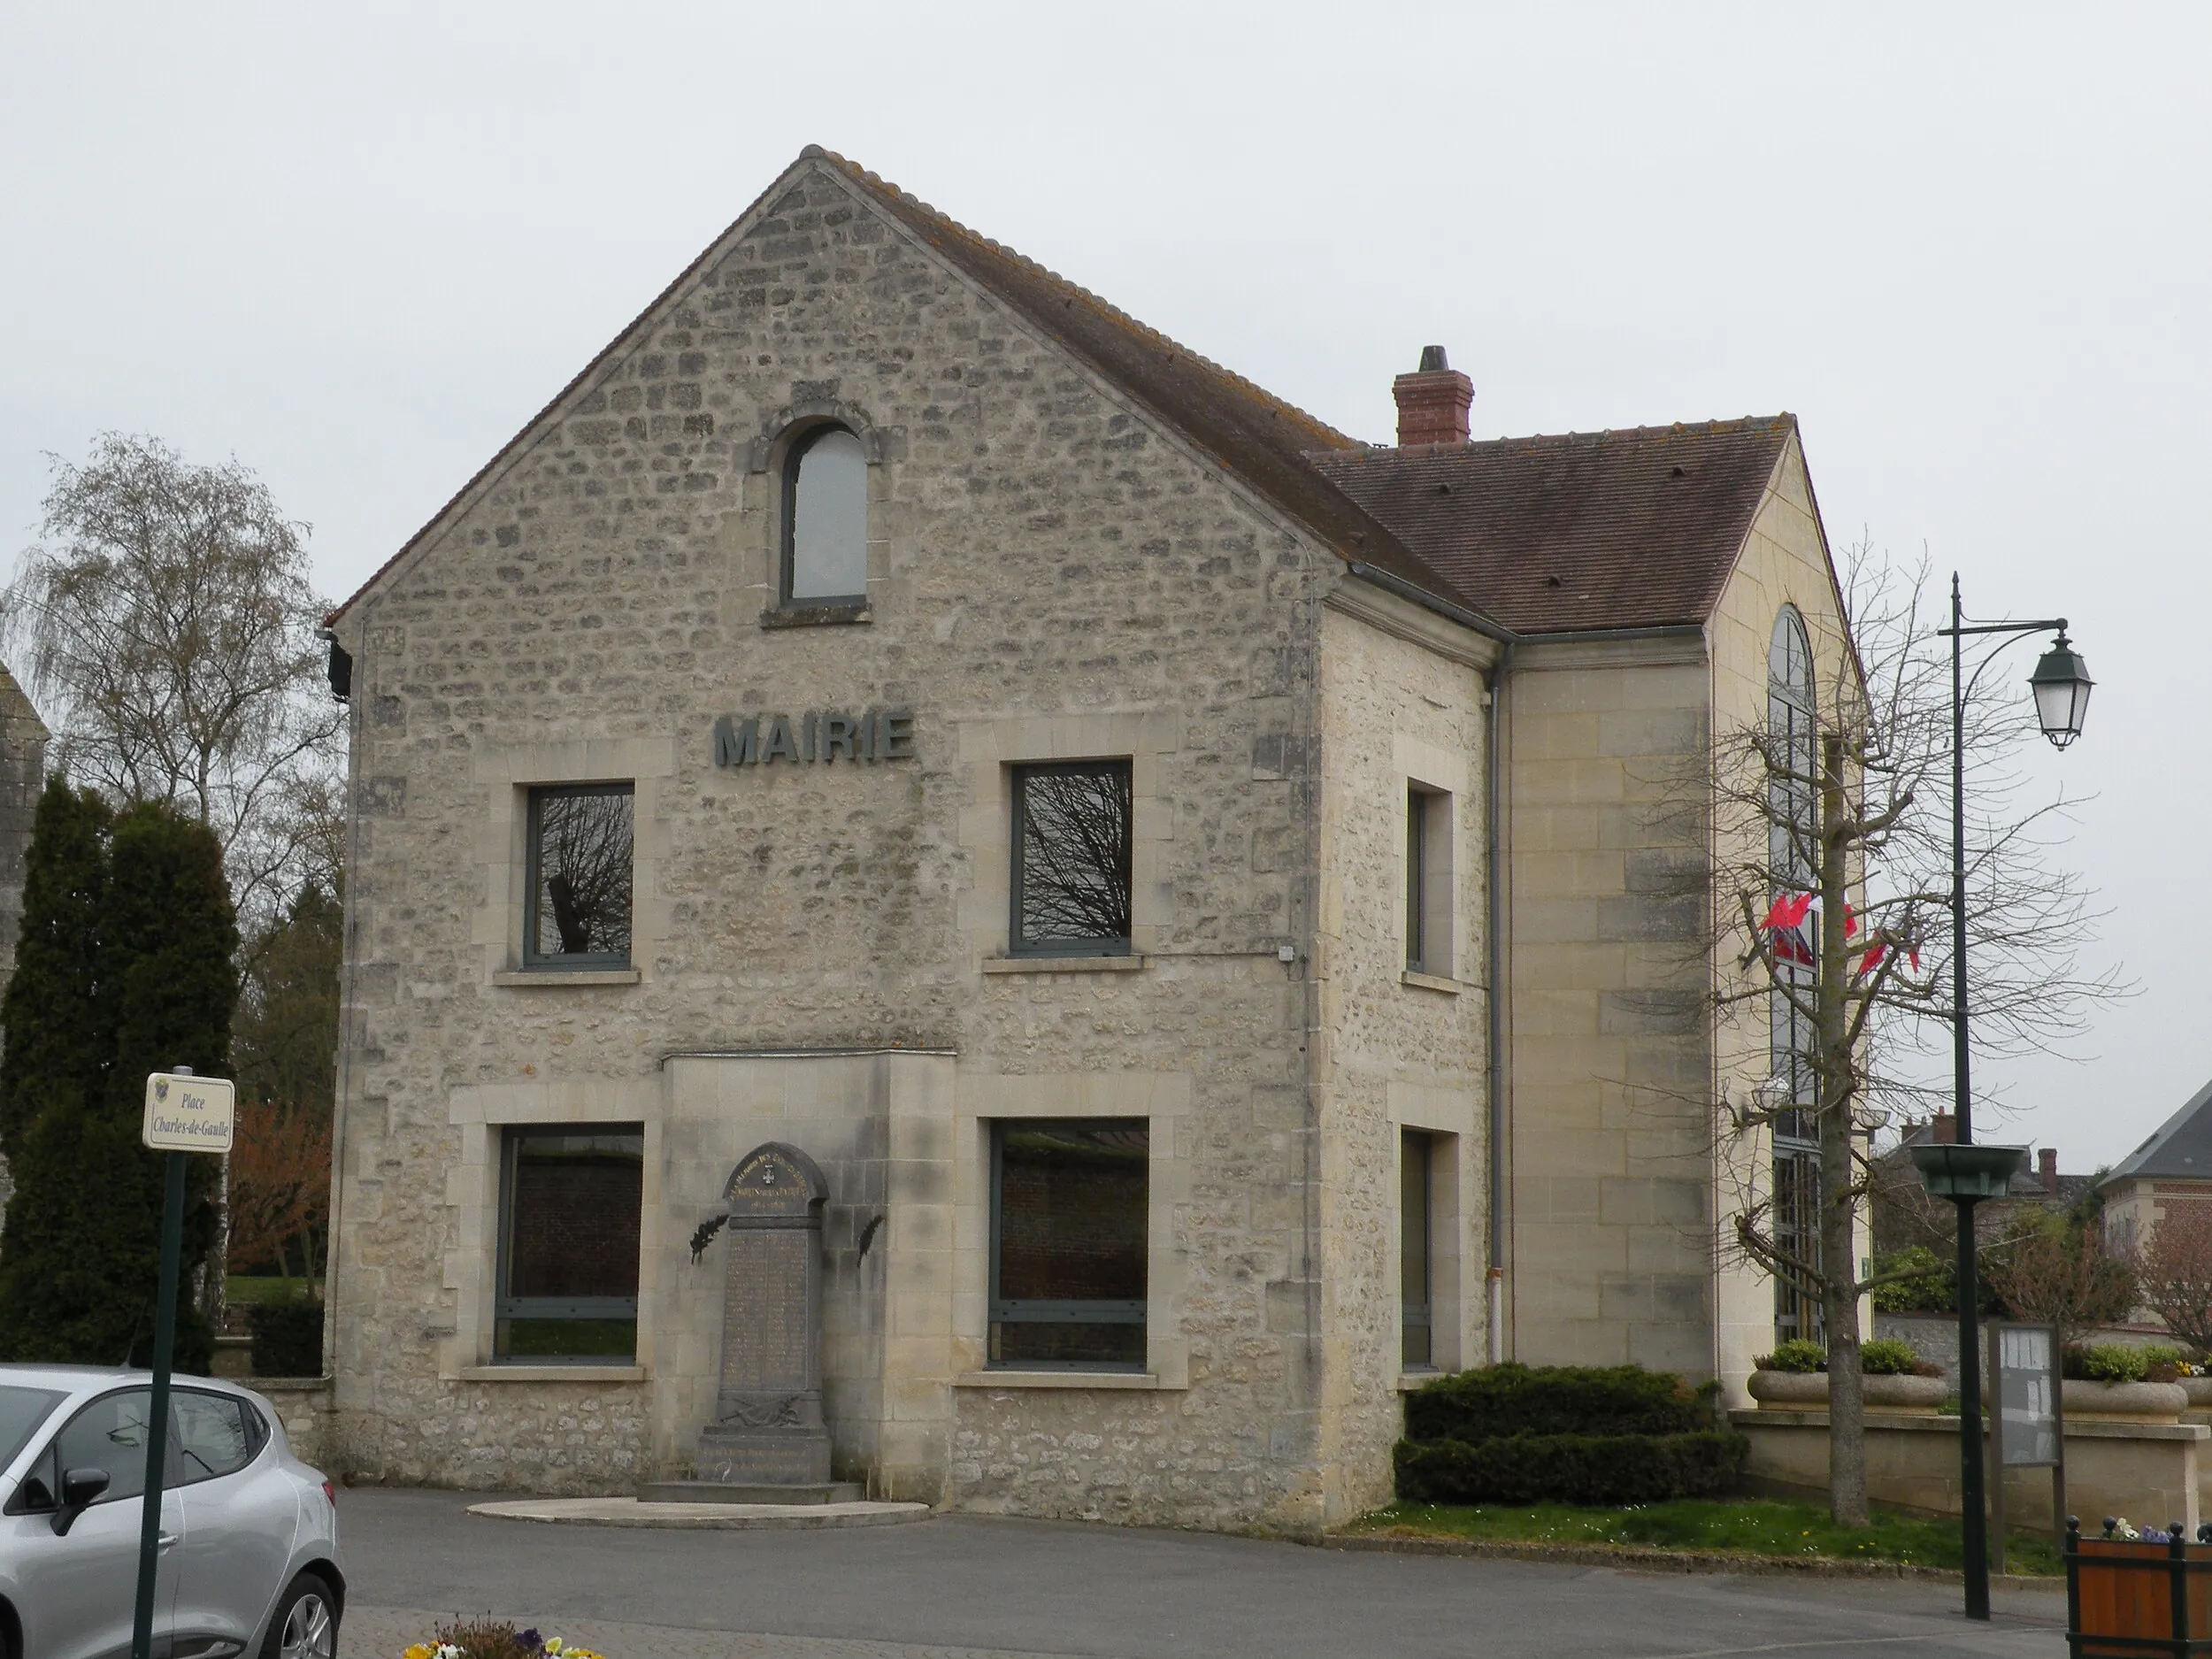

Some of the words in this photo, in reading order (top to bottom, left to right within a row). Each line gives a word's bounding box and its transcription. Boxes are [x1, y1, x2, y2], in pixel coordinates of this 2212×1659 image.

[713, 710, 914, 766] MAIRIE
[181, 1093, 205, 1110] Place
[153, 1116, 228, 1137] Charles-de-Gaulle
